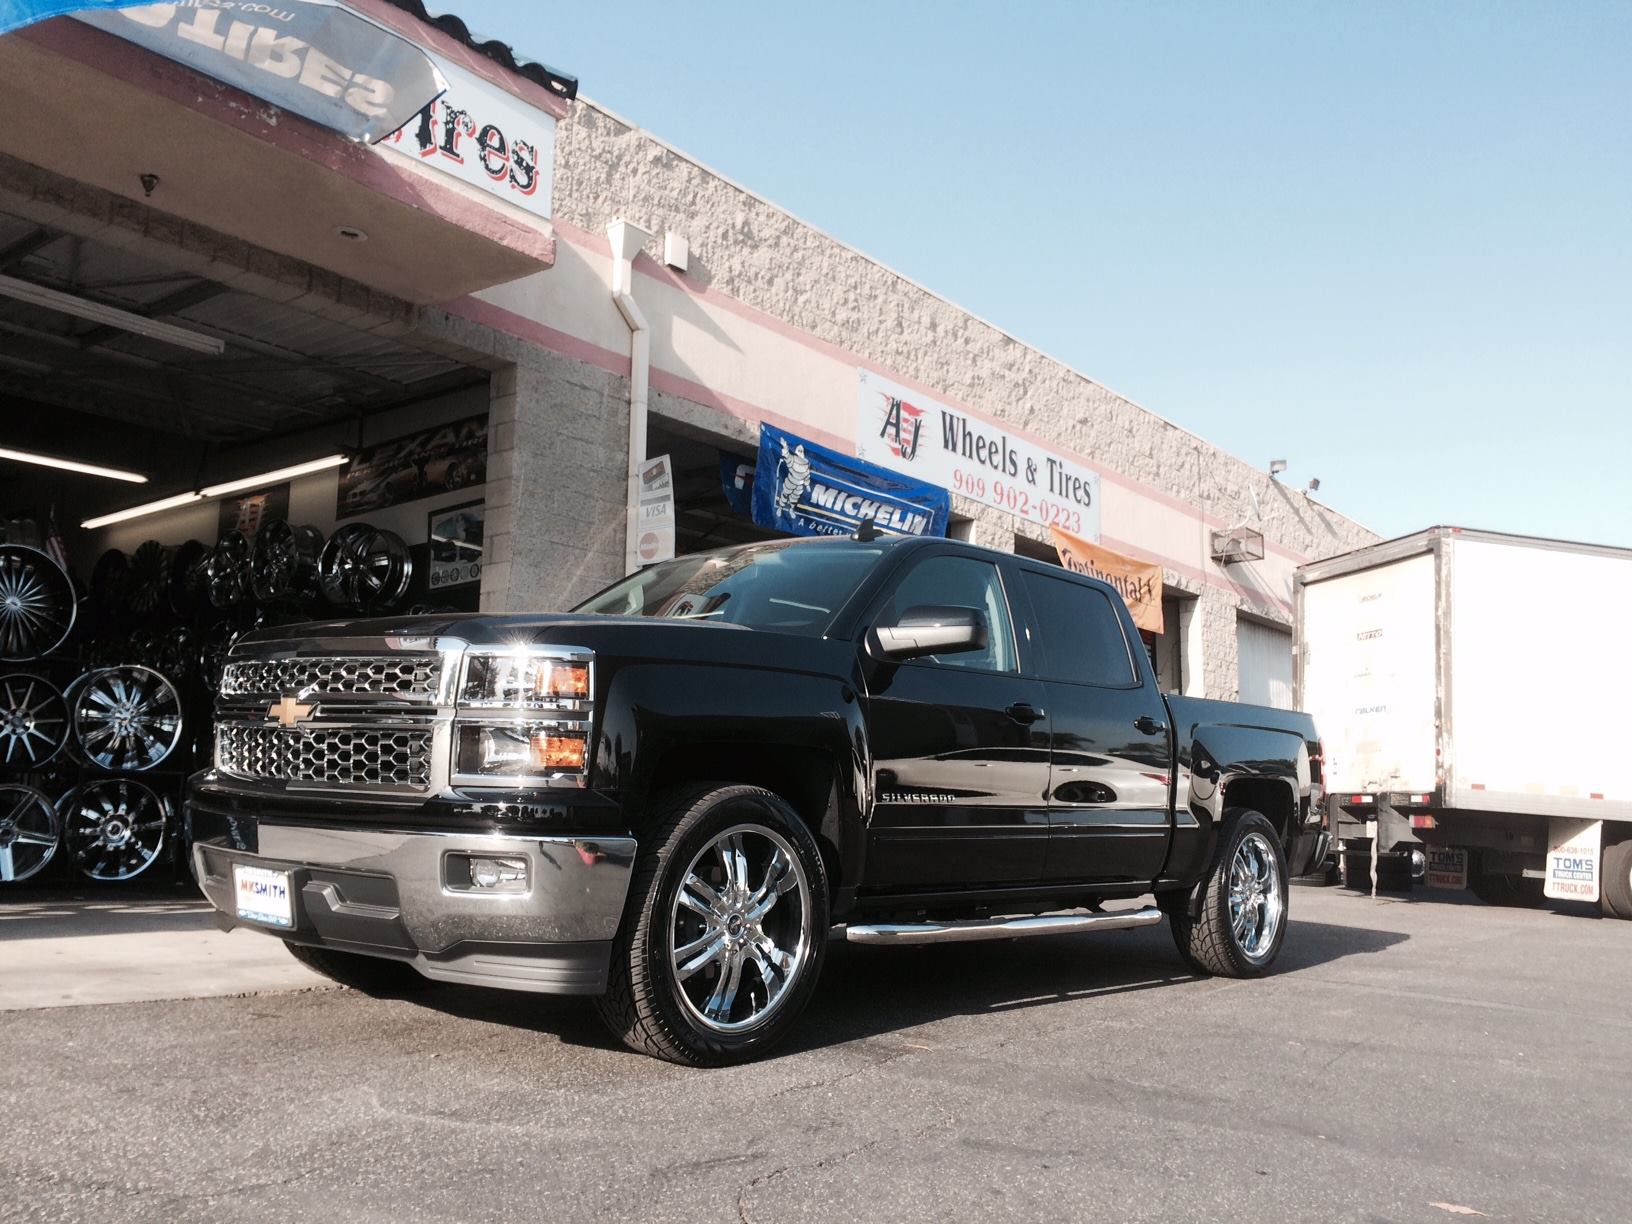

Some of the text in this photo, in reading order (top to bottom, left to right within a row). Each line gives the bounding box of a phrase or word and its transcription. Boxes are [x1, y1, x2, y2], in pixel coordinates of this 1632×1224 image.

[383, 98, 540, 197] ires
[941, 409, 1018, 478] Wheels
[1025, 456, 1038, 486] &
[1047, 456, 1092, 508] Tires
[646, 503, 667, 518] VISA
[811, 483, 928, 537] MICHELIN
[953, 468, 1082, 534] 909 902-0223
